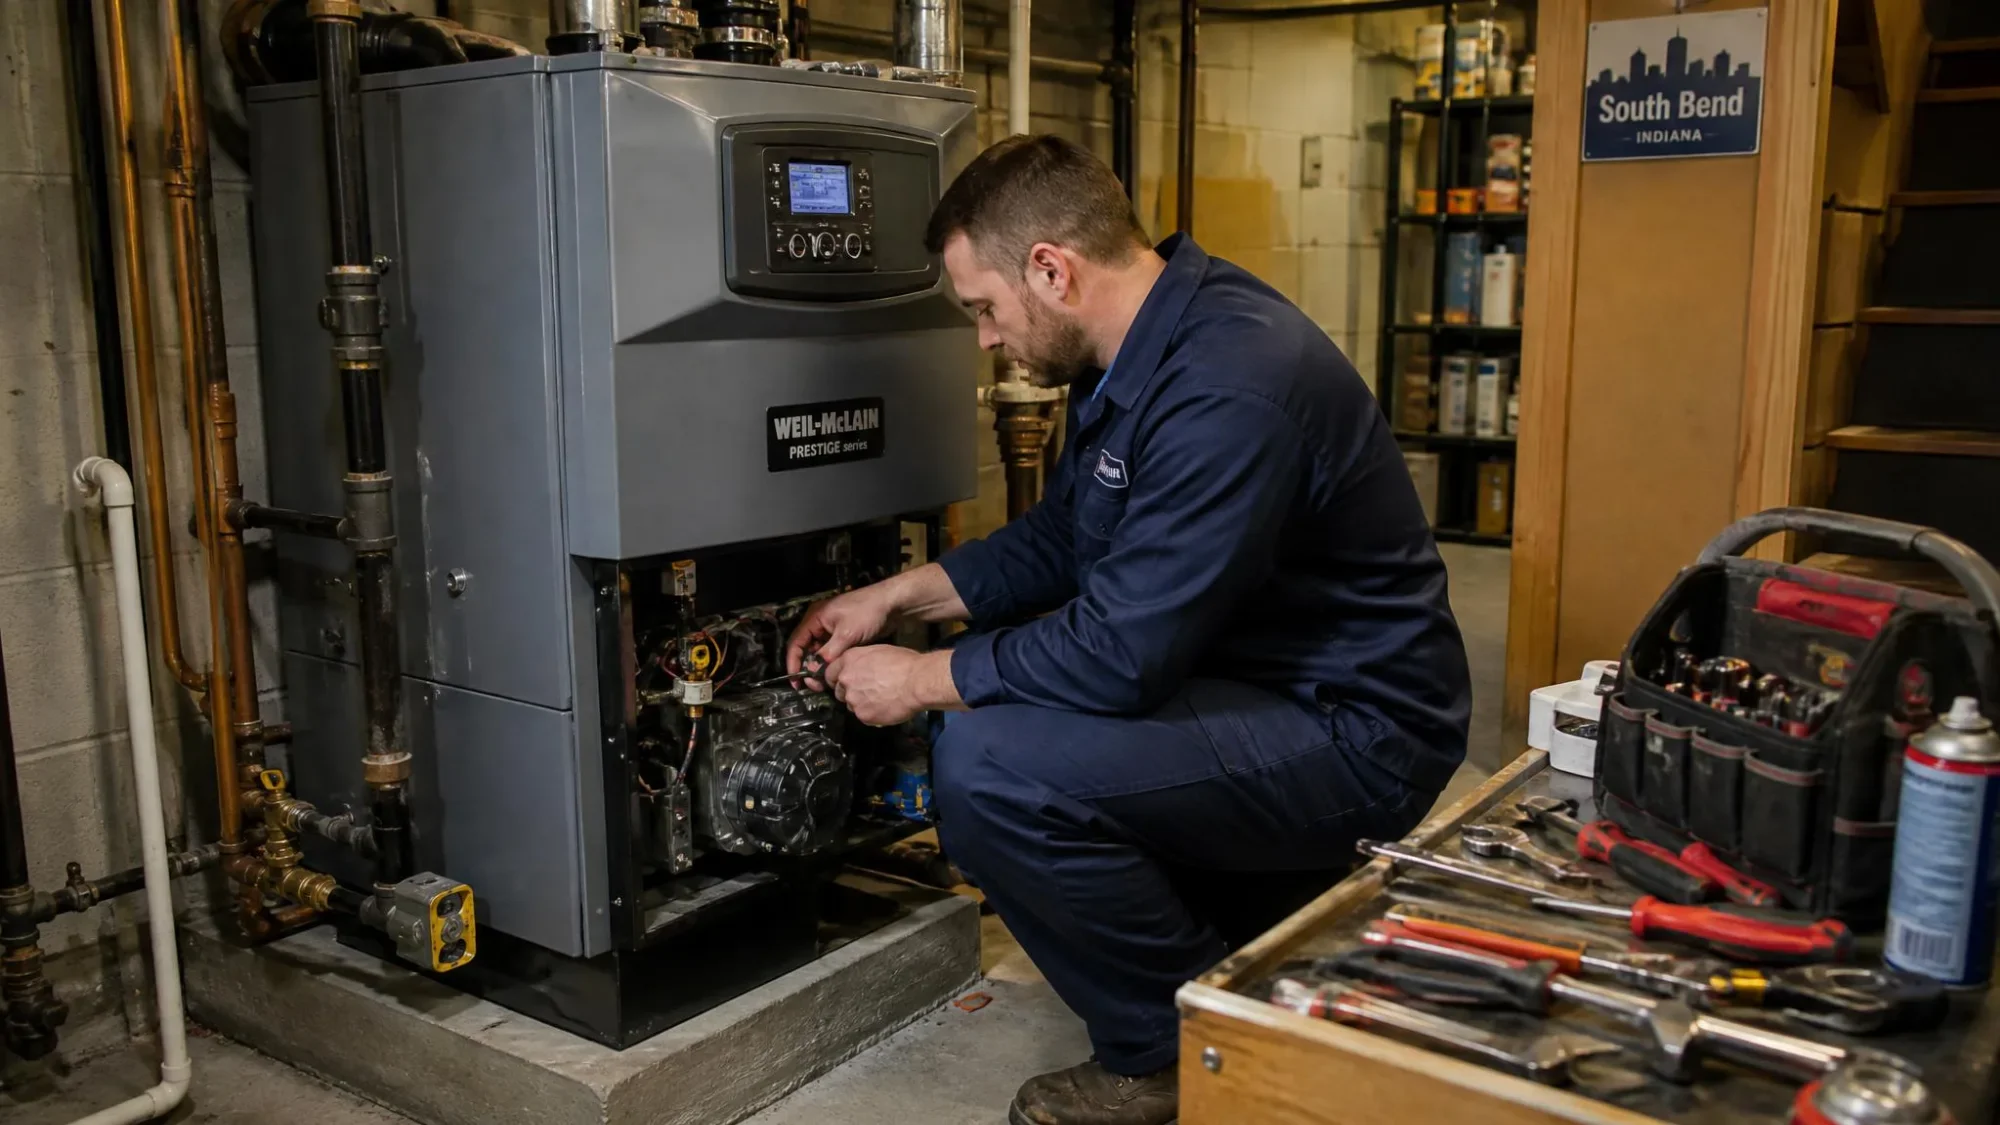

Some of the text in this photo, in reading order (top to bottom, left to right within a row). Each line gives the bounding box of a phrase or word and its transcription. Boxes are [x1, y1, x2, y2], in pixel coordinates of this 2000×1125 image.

[1599, 86, 1744, 123] South Bend
[1636, 128, 1702, 144] INDIANA
[774, 408, 879, 440] WEIL-McLAIN
[789, 439, 868, 459] PRESTIGE series
